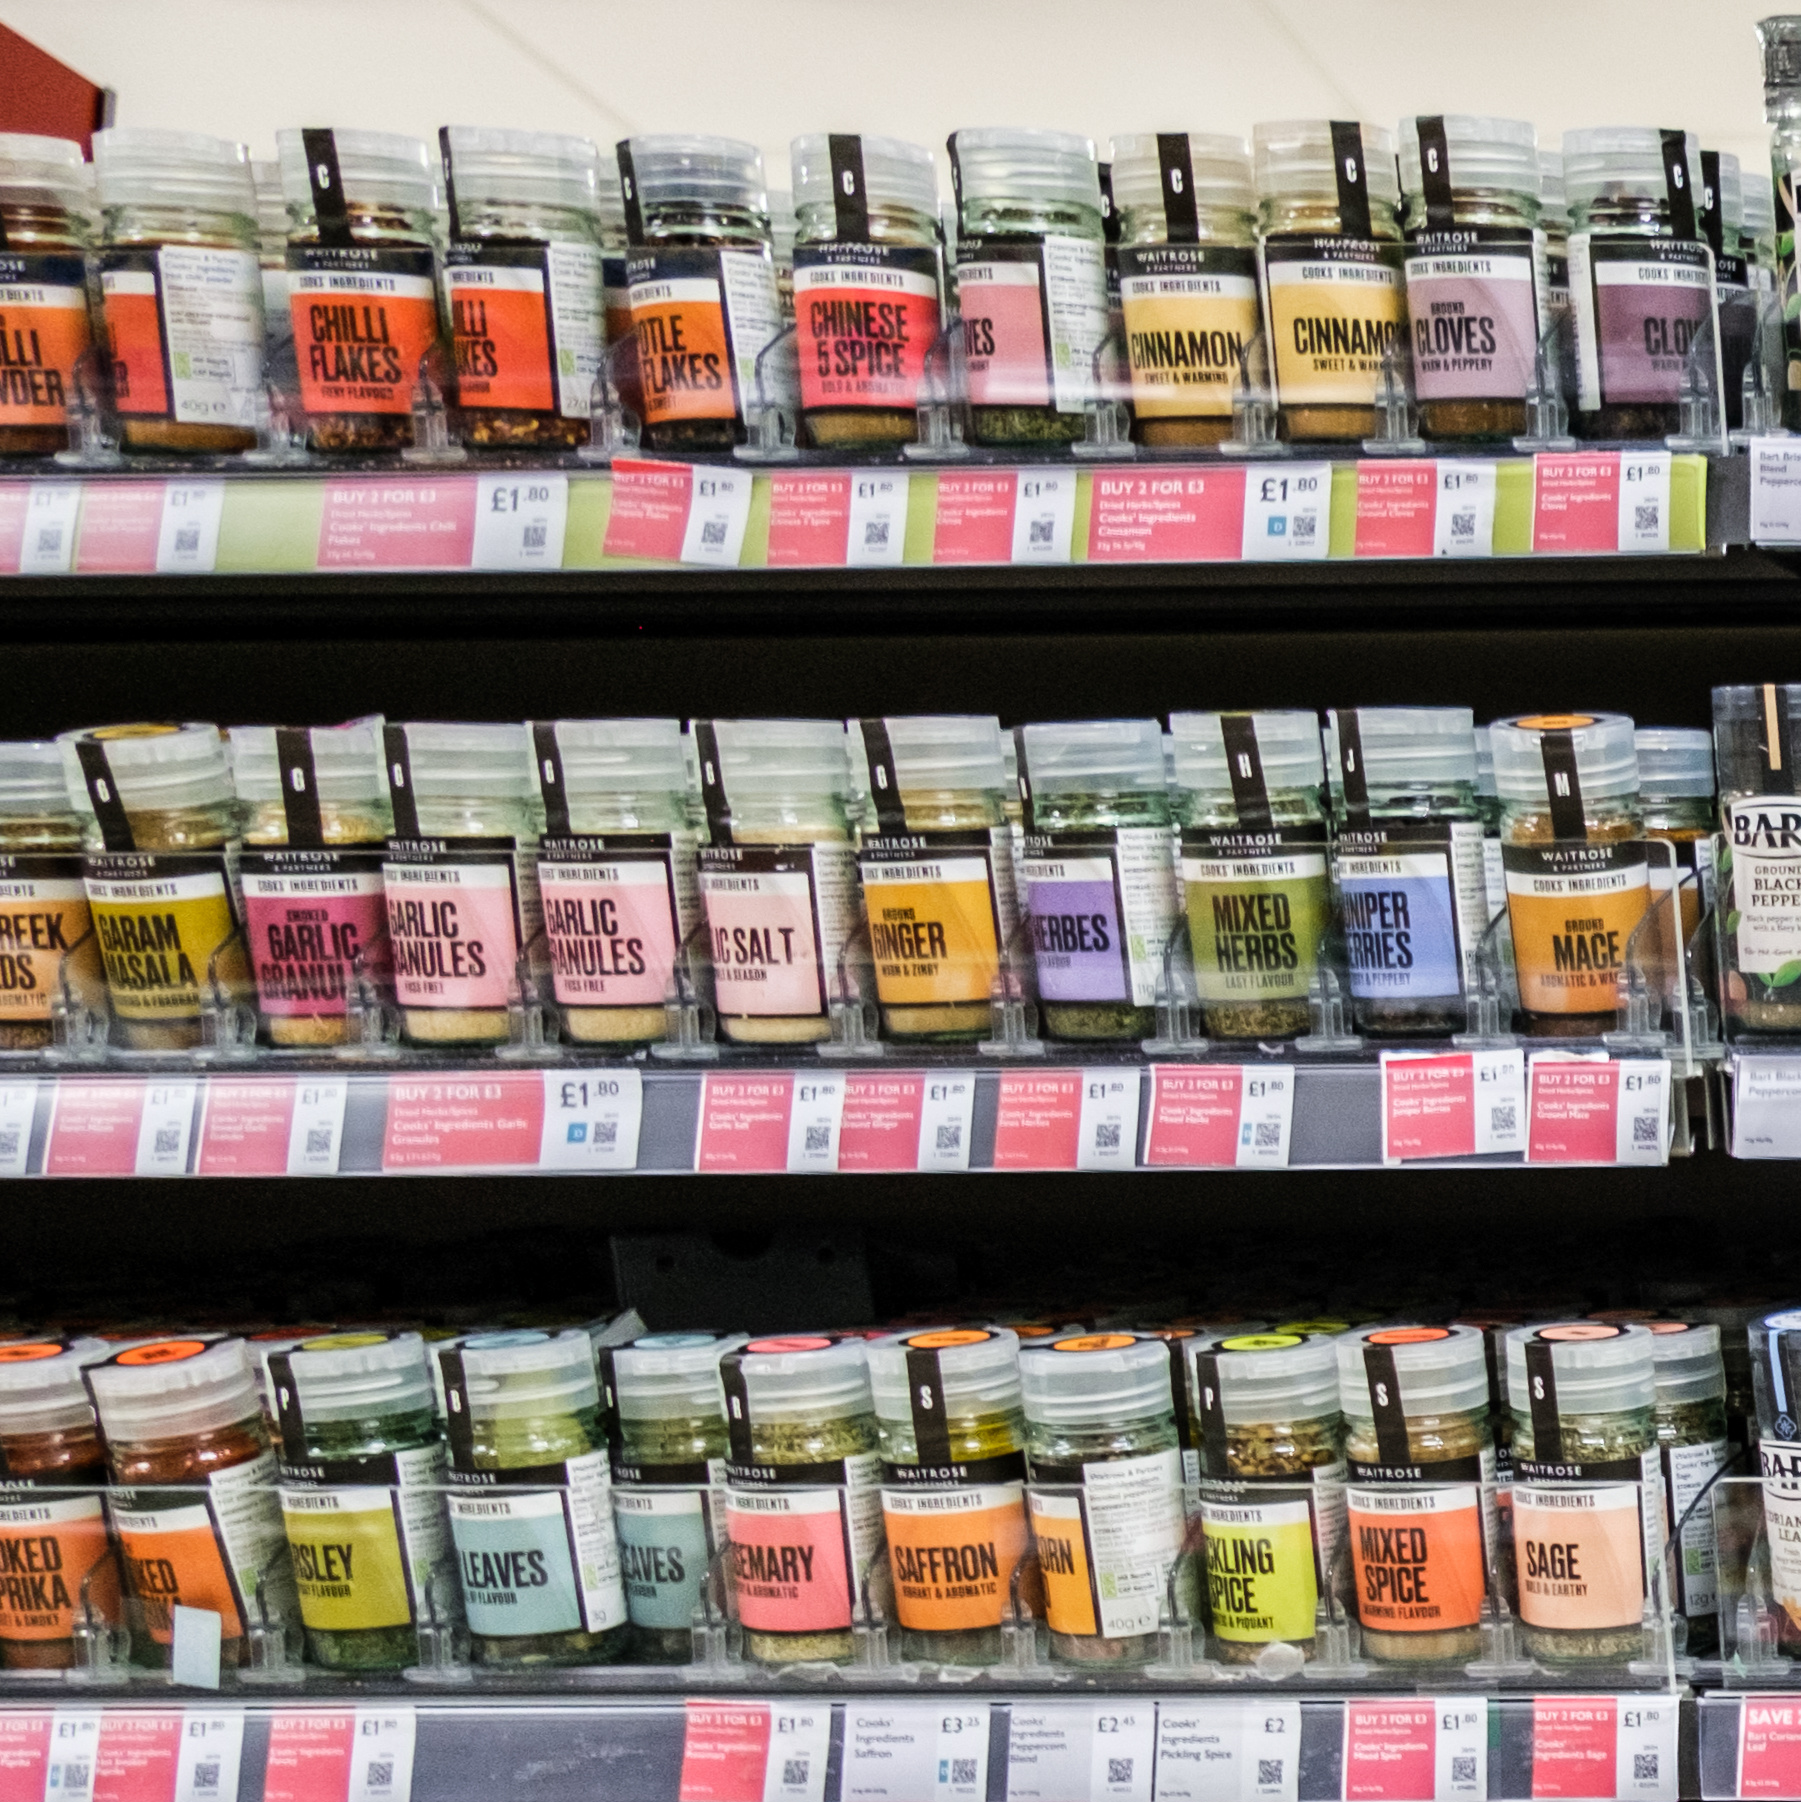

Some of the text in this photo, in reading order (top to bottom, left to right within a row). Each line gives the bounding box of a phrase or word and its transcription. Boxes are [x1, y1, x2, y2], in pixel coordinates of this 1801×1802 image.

[310, 304, 389, 343] CHILLI
[1417, 318, 1494, 356] CLOVES
[311, 342, 401, 385] FLAKES
[1131, 332, 1241, 370] CINNAMON
[1213, 894, 1289, 933] MIXED
[873, 923, 945, 961] GINGER
[1216, 933, 1297, 971] HERBS
[1553, 933, 1621, 970] MACE
[896, 1545, 998, 1581] SAFFRON
[1360, 1529, 1427, 1564] MIXED
[1526, 1543, 1580, 1579] SAGE
[1365, 1564, 1427, 1602] SPICE
